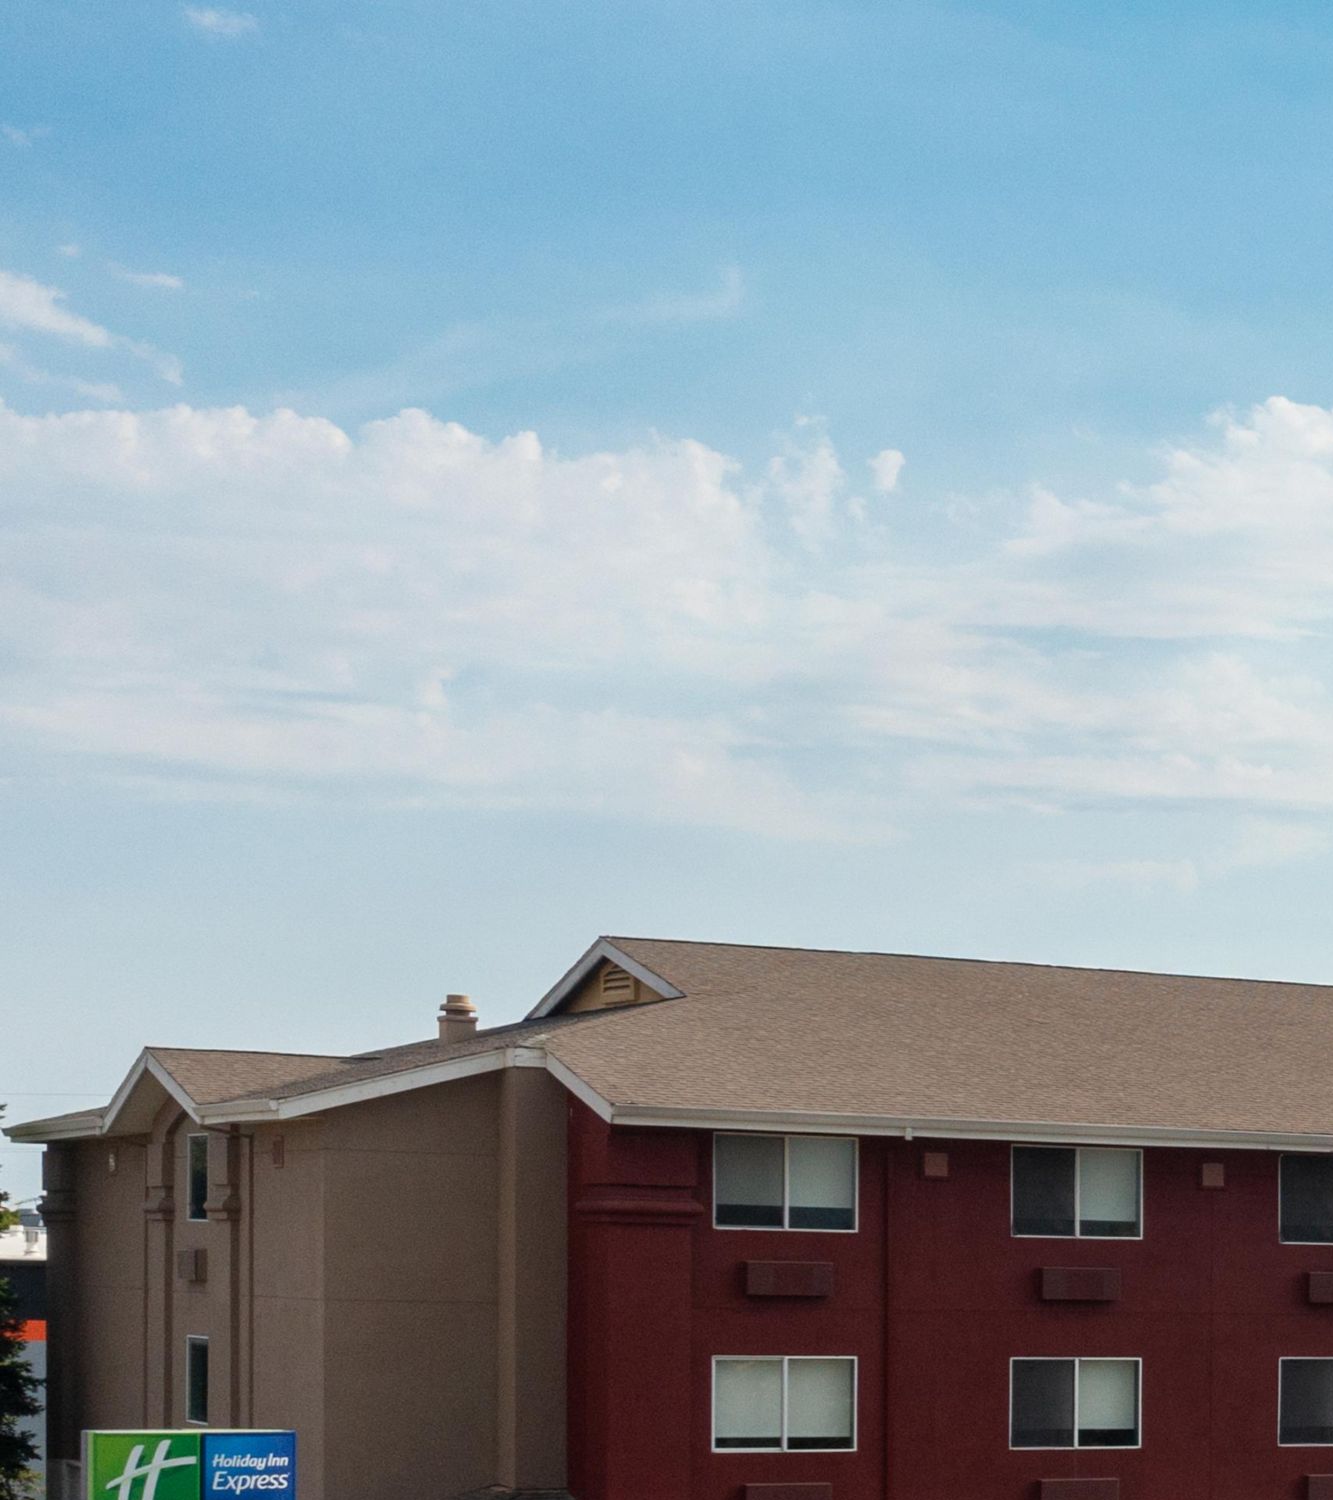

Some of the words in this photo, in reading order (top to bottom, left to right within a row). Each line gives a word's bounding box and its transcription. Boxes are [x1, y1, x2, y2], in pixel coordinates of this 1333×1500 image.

[212, 1453, 266, 1470] Holiday
[267, 1452, 289, 1467] Inn
[212, 1470, 289, 1495] Express
